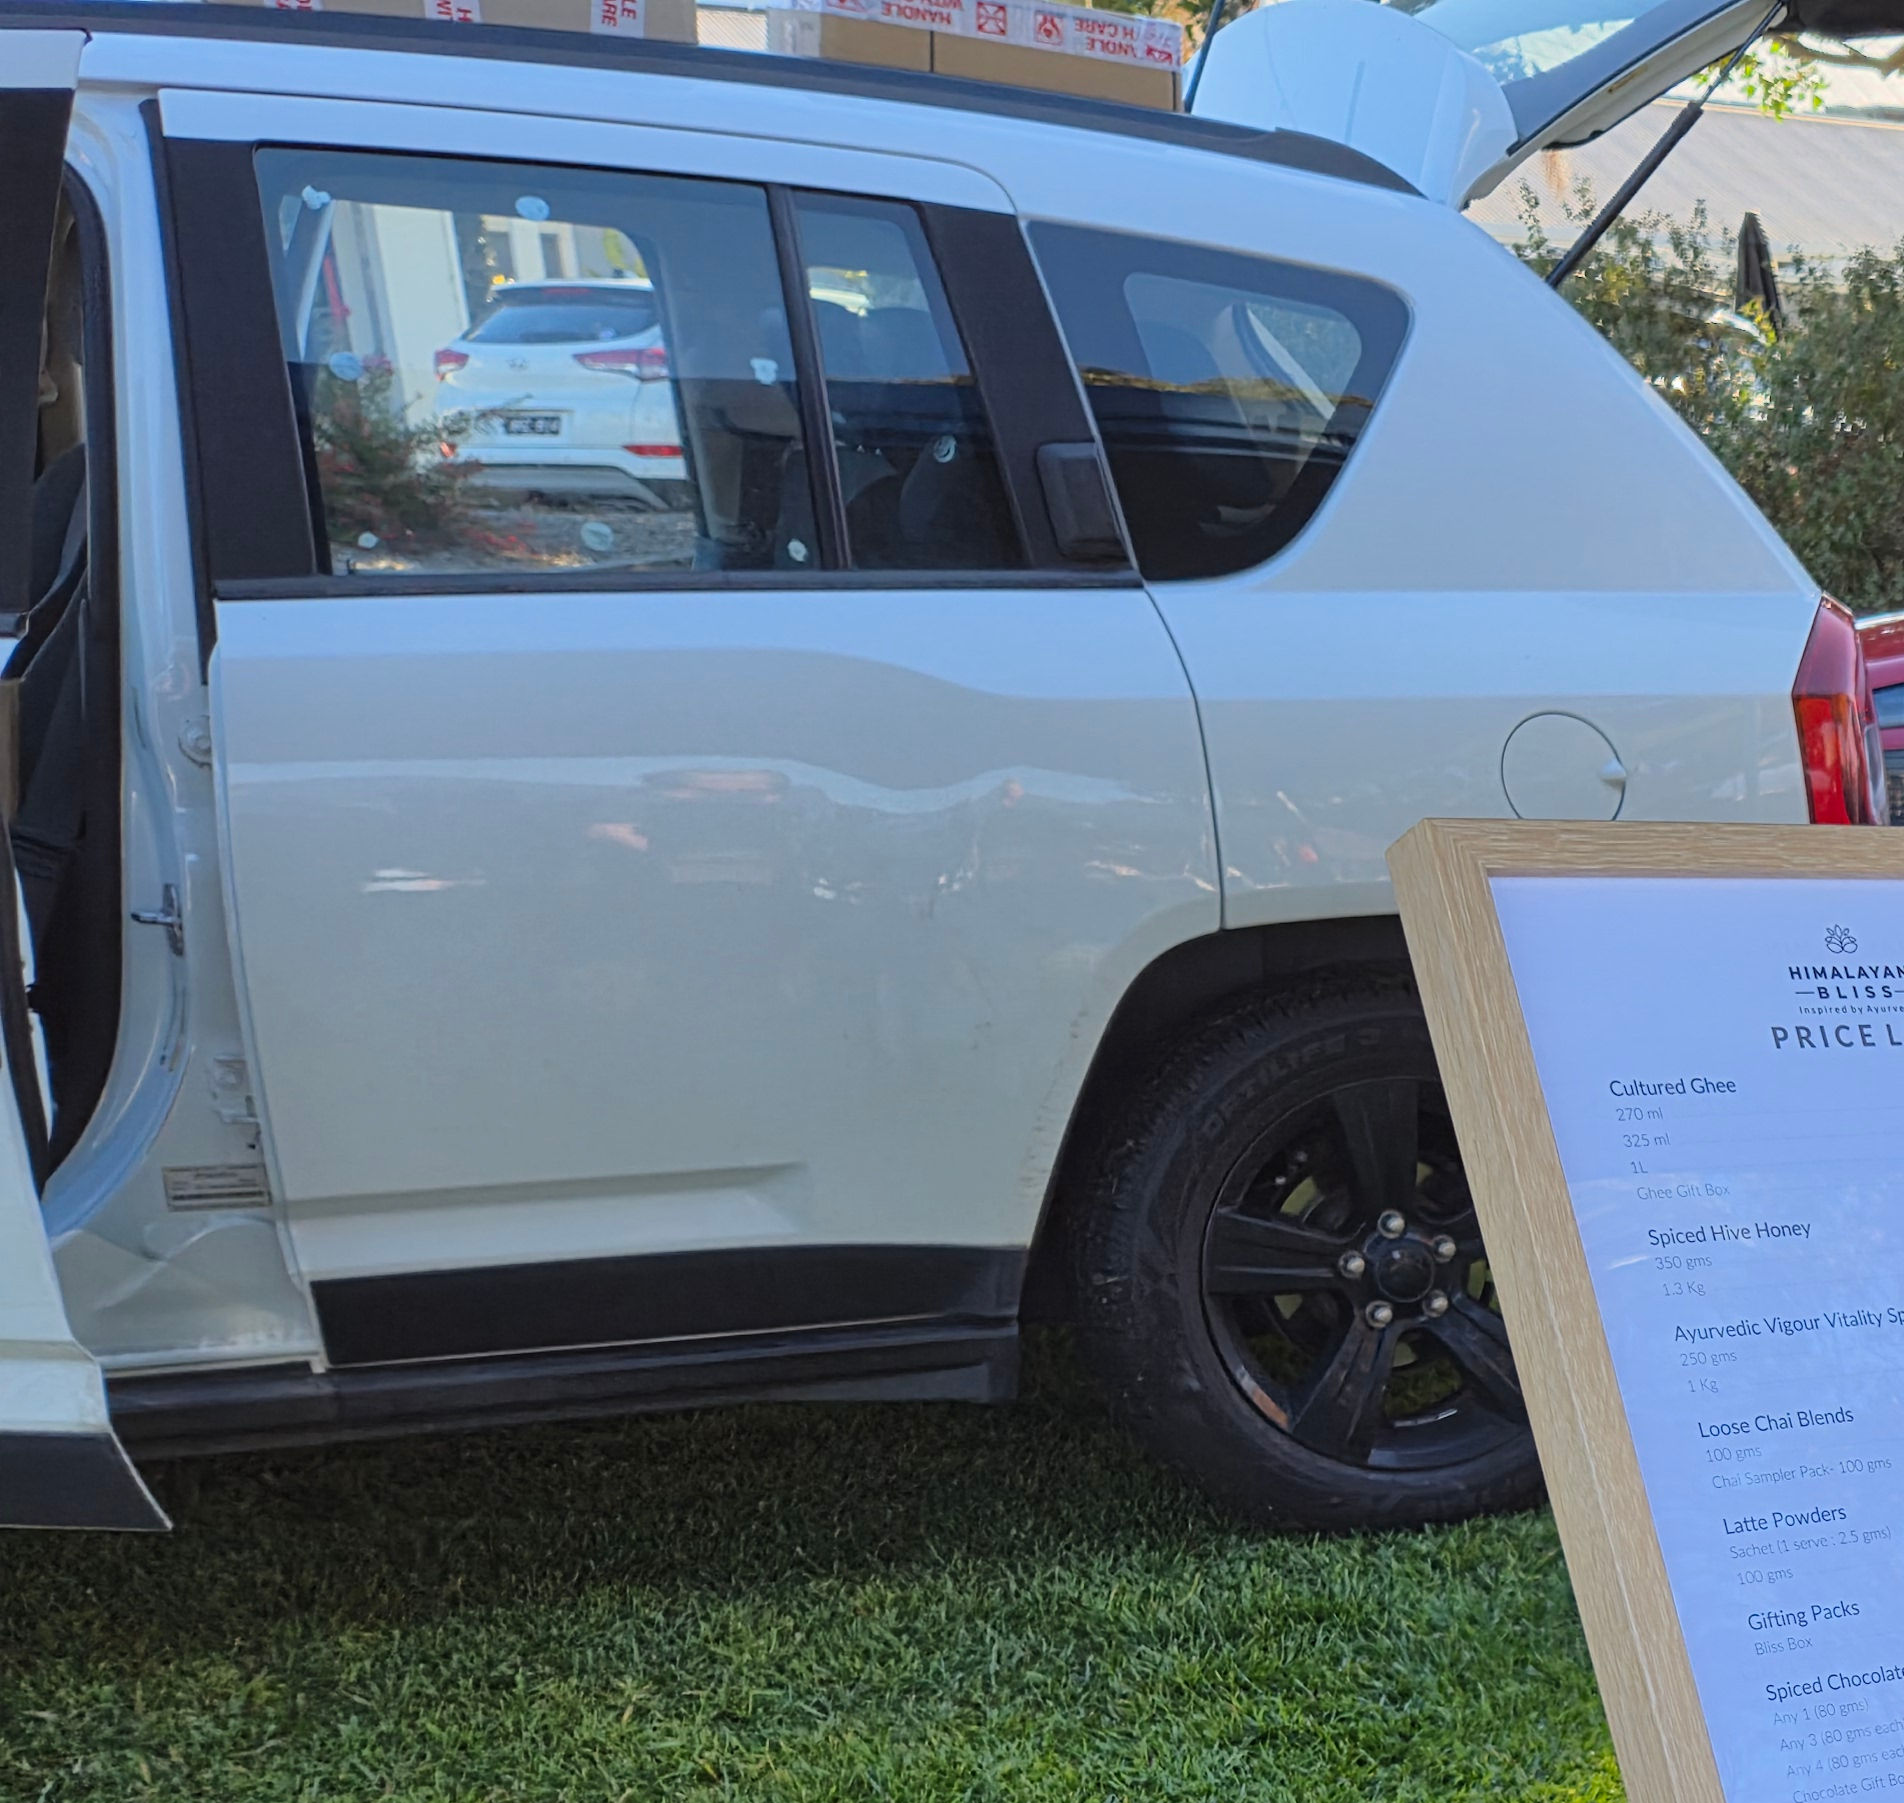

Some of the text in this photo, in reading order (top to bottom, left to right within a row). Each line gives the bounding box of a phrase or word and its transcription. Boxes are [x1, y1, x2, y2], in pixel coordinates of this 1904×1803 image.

[1816, 985, 1893, 1000] BLISS
[1798, 1004, 1848, 1015] Inspired
[1850, 1004, 1864, 1016] by
[1771, 1024, 1877, 1050] PRICE
[1609, 1077, 1738, 1098] Cultured Ghee
[1616, 1106, 1664, 1122] 270 ml
[1623, 1132, 1671, 1148] 325 ml
[1630, 1160, 1649, 1175] 1L
[1637, 1182, 1731, 1201] Ghee Gift Box
[1648, 1220, 1811, 1249] Spiced Hive Honey
[1654, 1255, 1713, 1271] 350 gms
[1662, 1280, 1707, 1297] 1.3 Kg
[1674, 1320, 1762, 1344] Ayurvedic
[1763, 1315, 1821, 1336] Vigour
[1823, 1309, 1883, 1329] Vitality
[1680, 1352, 1707, 1367] 250
[1697, 1407, 1855, 1439] Loose Chai Blends
[1712, 1473, 1742, 1490] Chai
[1745, 1467, 1797, 1487] Sampler
[1839, 1459, 1865, 1474] 100
[1867, 1457, 1892, 1474] gms
[1723, 1505, 1848, 1536] Latte Powders
[1728, 1541, 1775, 1560] Sachet
[1747, 1600, 1861, 1632] Gifting Packs
[1754, 1636, 1814, 1657] Bliss Box
[1764, 1678, 1824, 1703] Spiced
[1861, 1774, 1888, 1792] Gift
